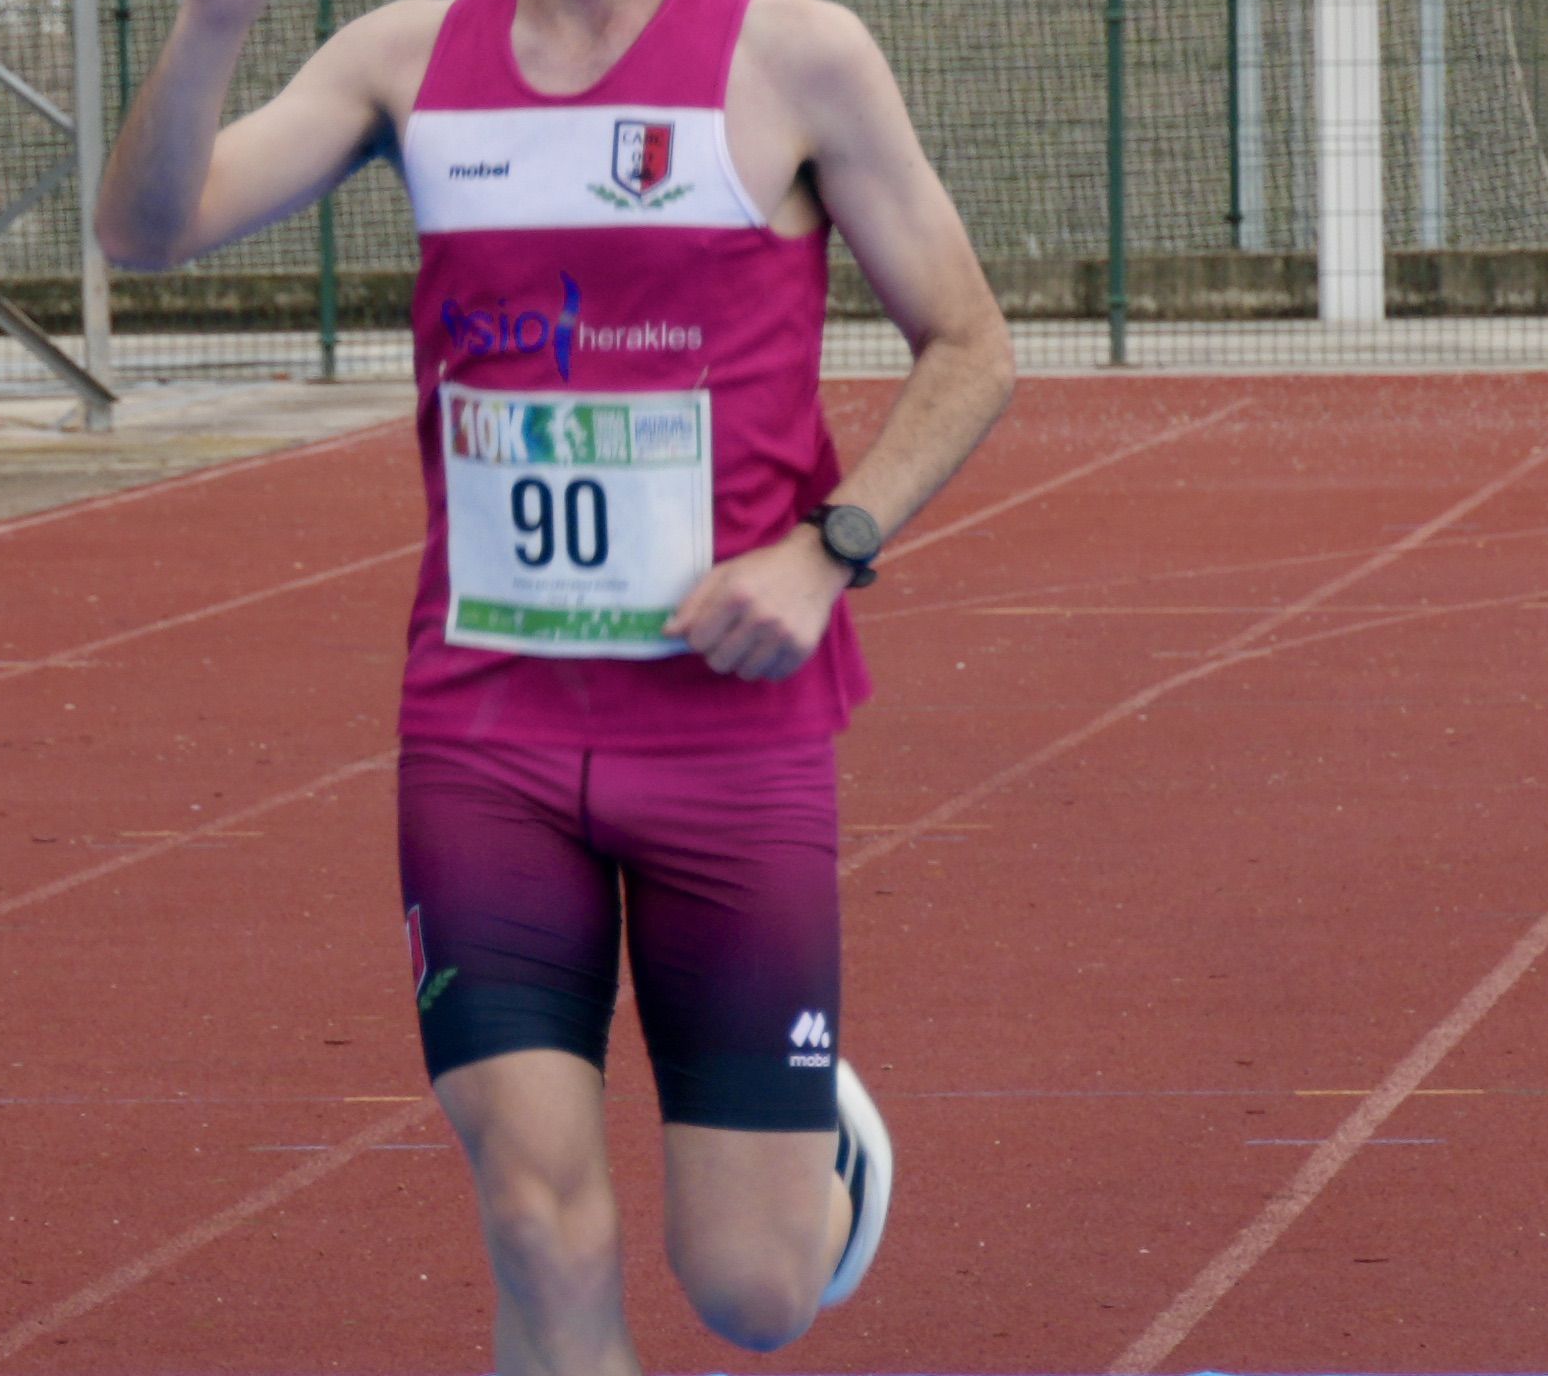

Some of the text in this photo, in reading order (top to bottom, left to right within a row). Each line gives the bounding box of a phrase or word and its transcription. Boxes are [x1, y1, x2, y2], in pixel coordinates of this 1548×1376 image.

[579, 320, 702, 351] herakles
[460, 399, 528, 462] 10K
[510, 476, 609, 570] 90
